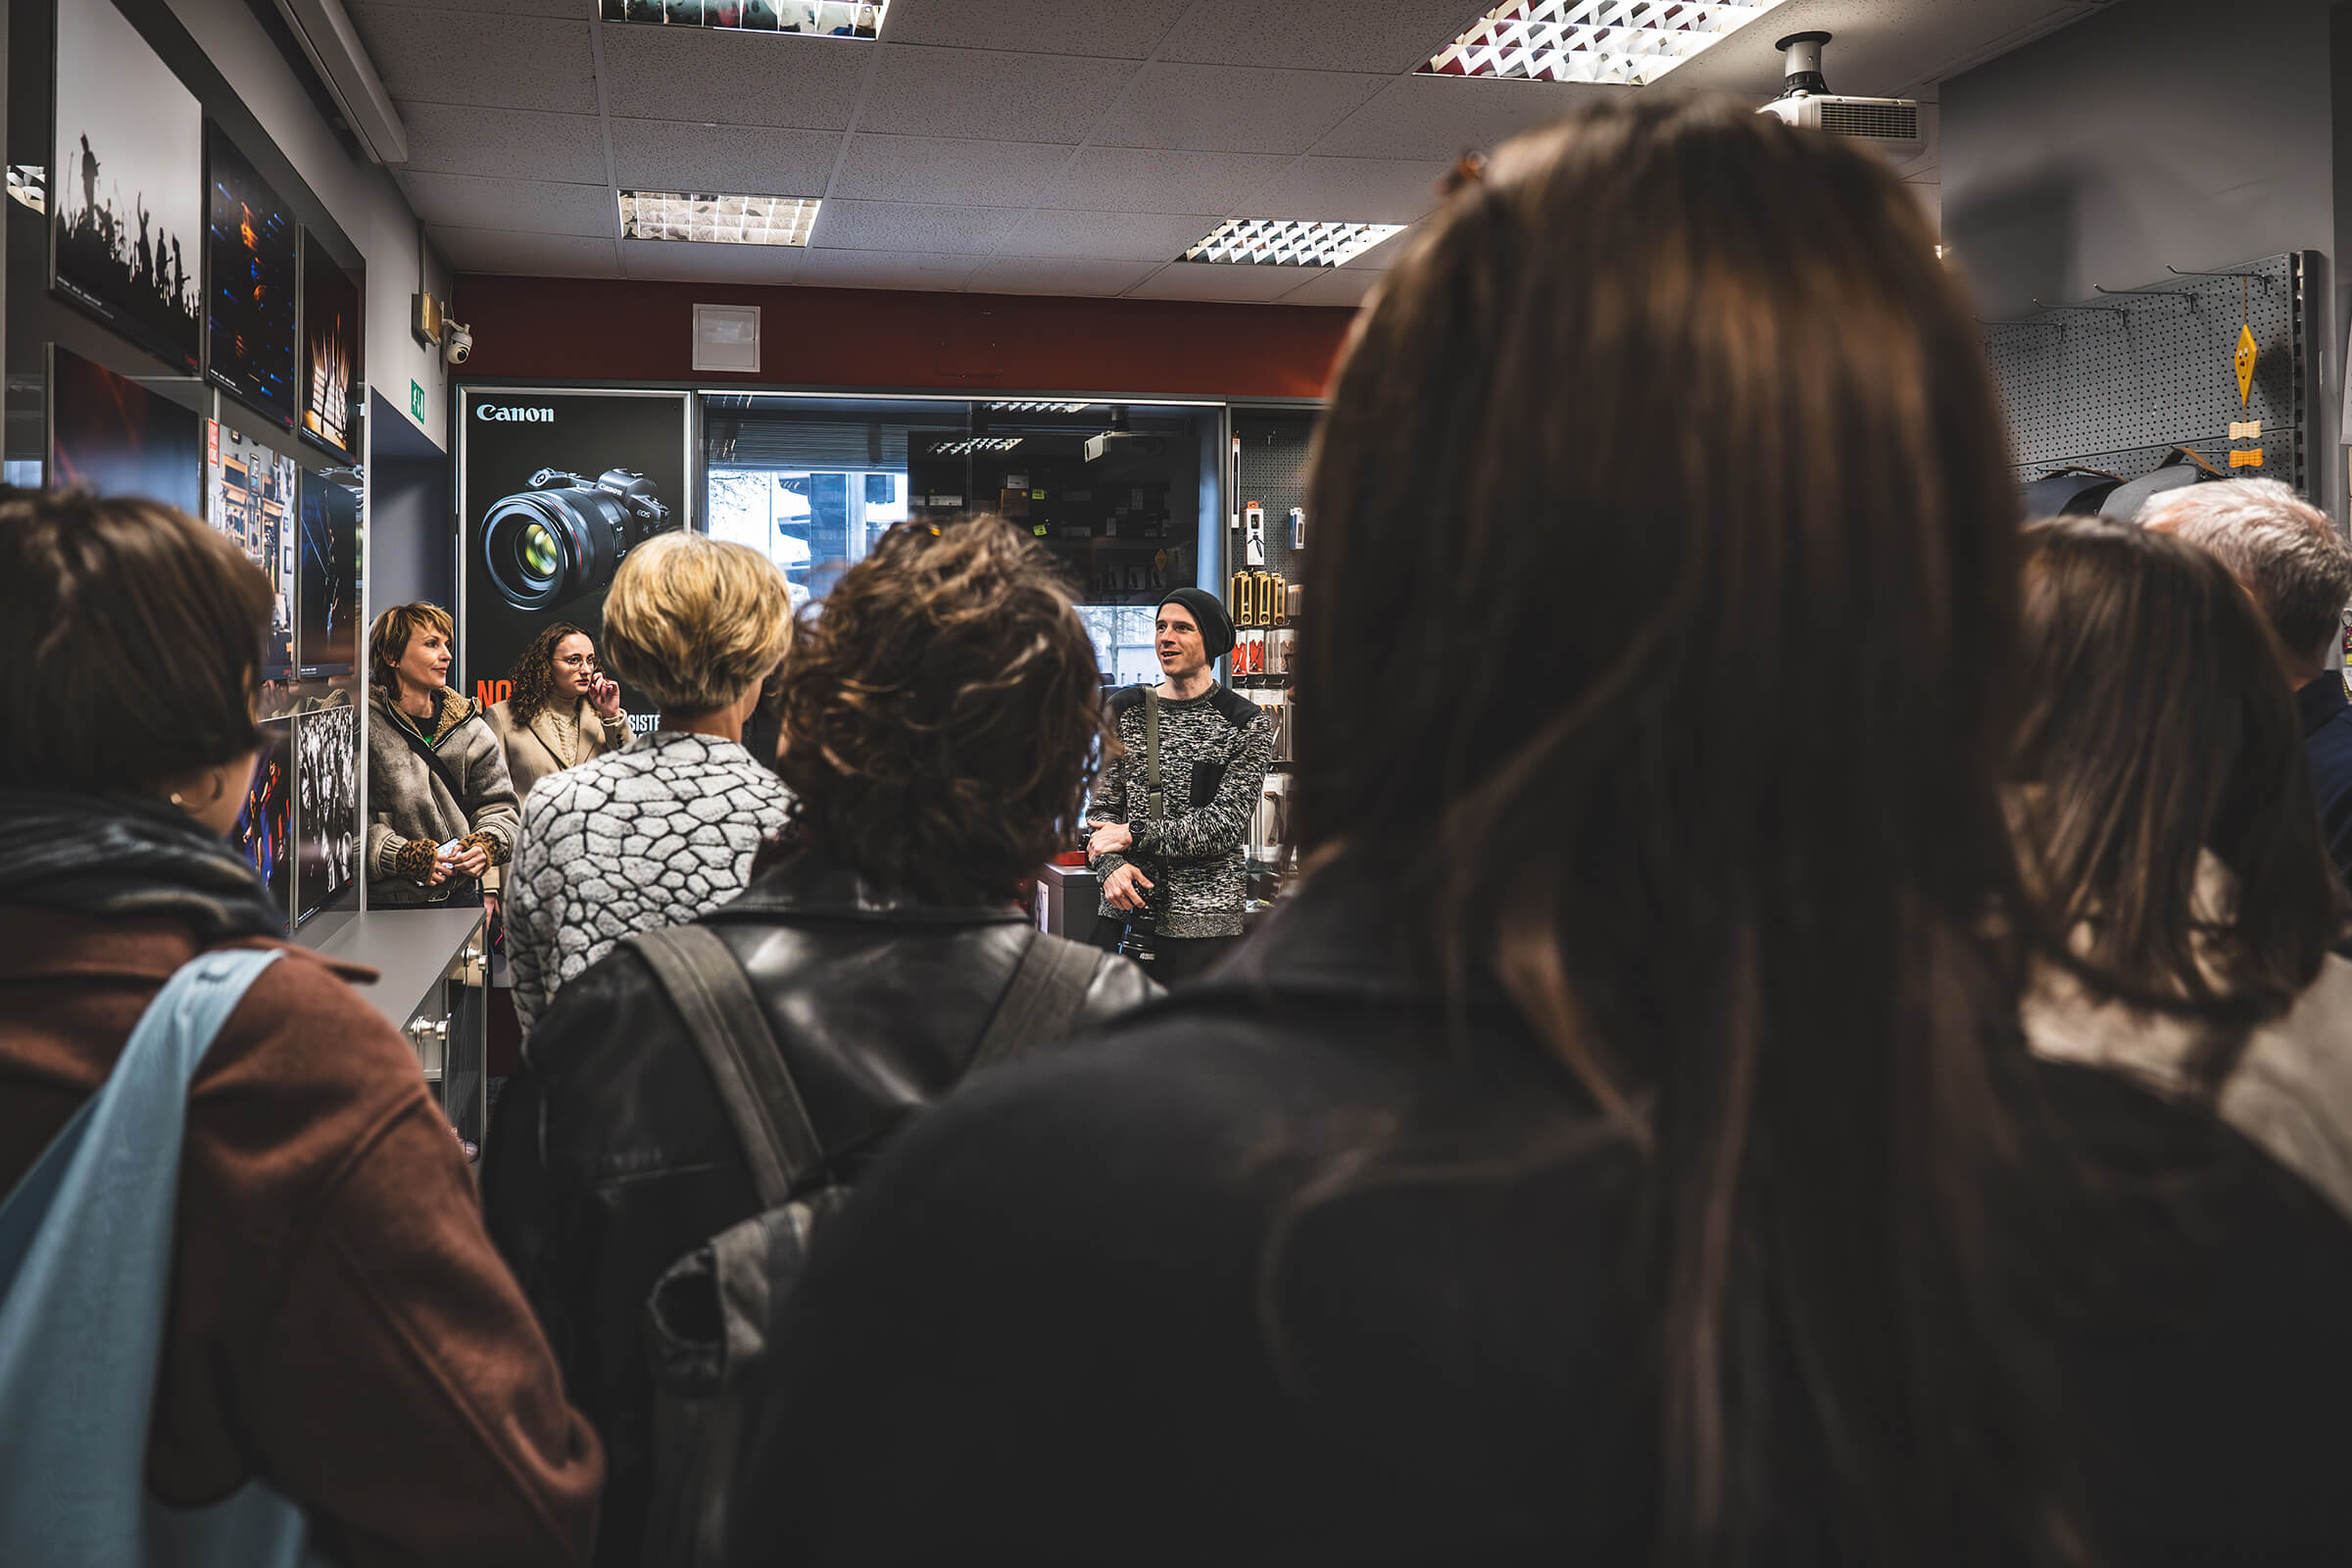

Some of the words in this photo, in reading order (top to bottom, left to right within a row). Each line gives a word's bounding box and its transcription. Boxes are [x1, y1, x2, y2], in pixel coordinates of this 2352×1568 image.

[476, 404, 555, 422] Canon
[598, 483, 623, 496] Canon
[636, 509, 652, 518] EOS
[477, 679, 517, 714] NO
